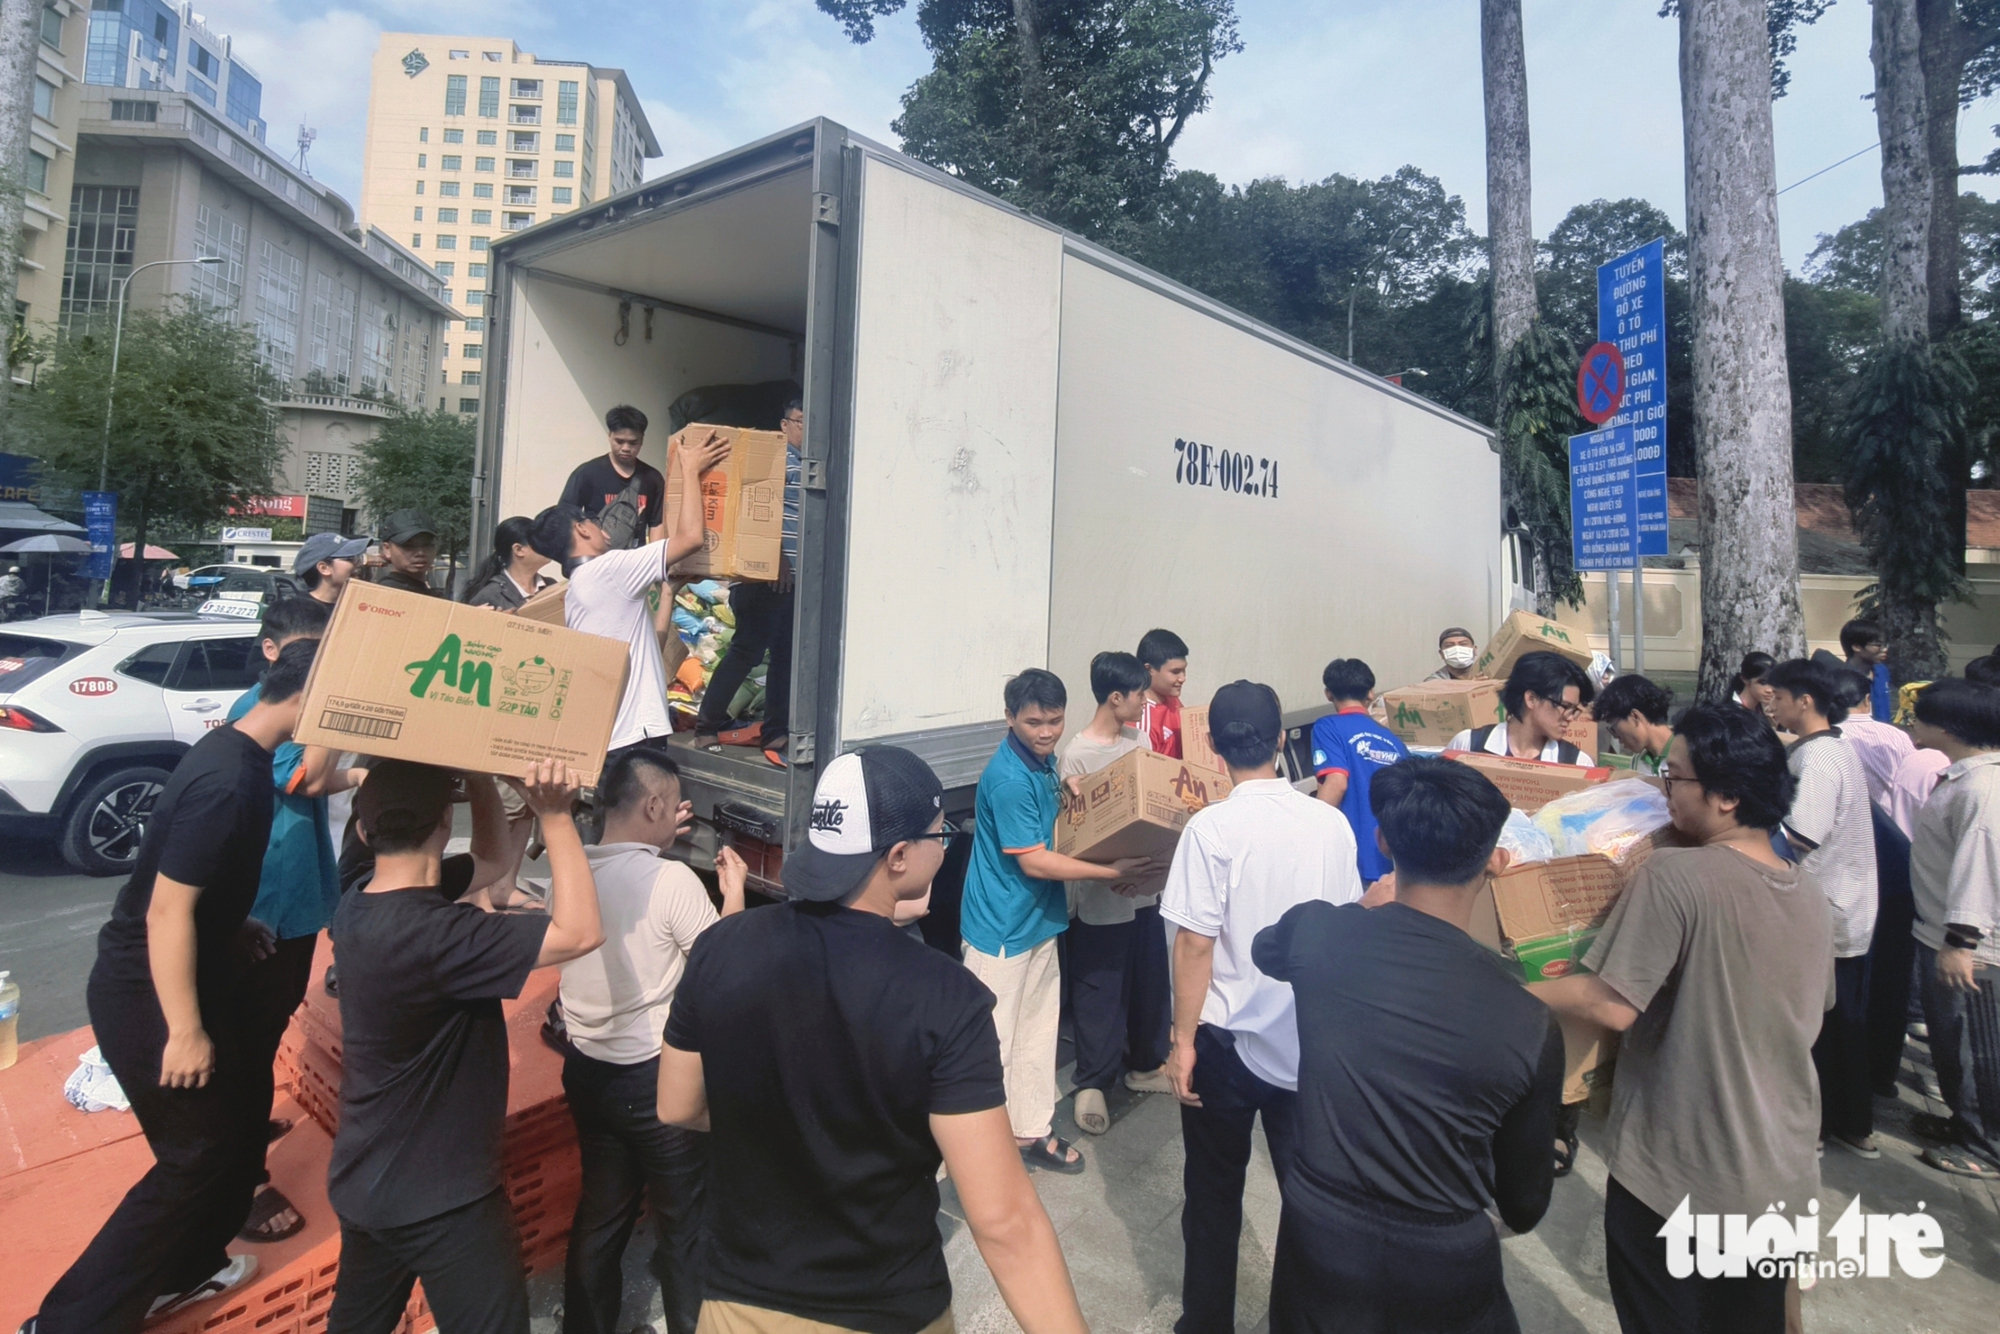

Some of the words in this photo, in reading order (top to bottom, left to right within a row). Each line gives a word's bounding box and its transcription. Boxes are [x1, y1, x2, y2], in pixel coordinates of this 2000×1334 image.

[1614, 253, 1644, 280] TUYẾN
[1614, 275, 1646, 299] ĐƯỜNG
[1616, 297, 1629, 317] ĐỖ
[1631, 295, 1643, 311] XE
[1618, 319, 1625, 334] Ô
[1628, 313, 1641, 330] TÔ
[1619, 335, 1637, 352] THU
[1640, 323, 1658, 346] PHÍ
[1623, 353, 1643, 370] HEO
[1635, 384, 1652, 404] PHÍ
[1633, 410, 1643, 423] 01
[1647, 401, 1665, 420] GIỜ
[1611, 485, 1624, 496] THEO
[706, 498, 719, 521] Kim
[237, 530, 270, 538] CRESTEC
[370, 605, 401, 617] ORION
[1536, 622, 1572, 645] An
[404, 633, 493, 707] An
[72, 681, 114, 692] 17808
[499, 701, 518, 712] 22P
[1393, 702, 1427, 729] An
[1170, 766, 1209, 805] An
